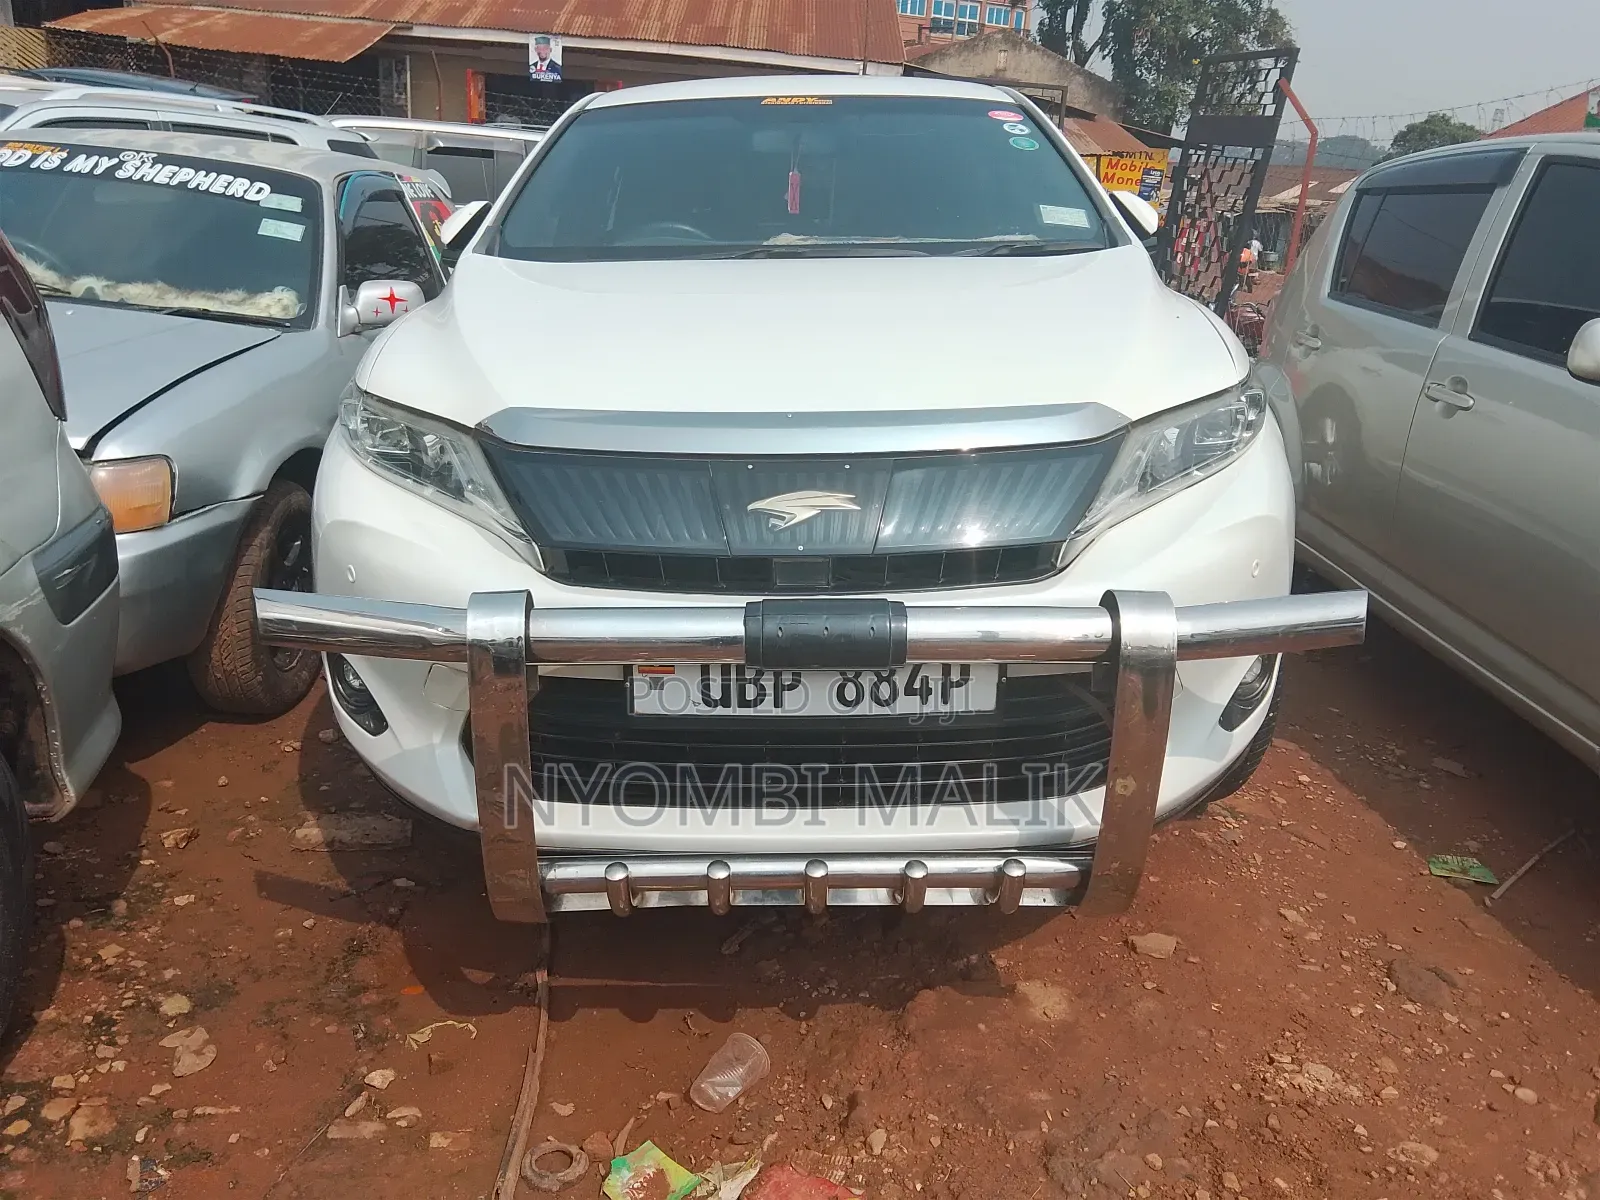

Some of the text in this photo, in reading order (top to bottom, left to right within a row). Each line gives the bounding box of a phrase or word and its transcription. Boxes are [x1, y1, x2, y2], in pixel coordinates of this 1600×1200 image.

[119, 151, 158, 164] OK
[30, 151, 68, 170] IS
[63, 154, 119, 175] MY
[115, 160, 271, 201] SHEPHERD
[1102, 172, 1141, 186] Mone
[700, 663, 971, 709] UBP 884P
